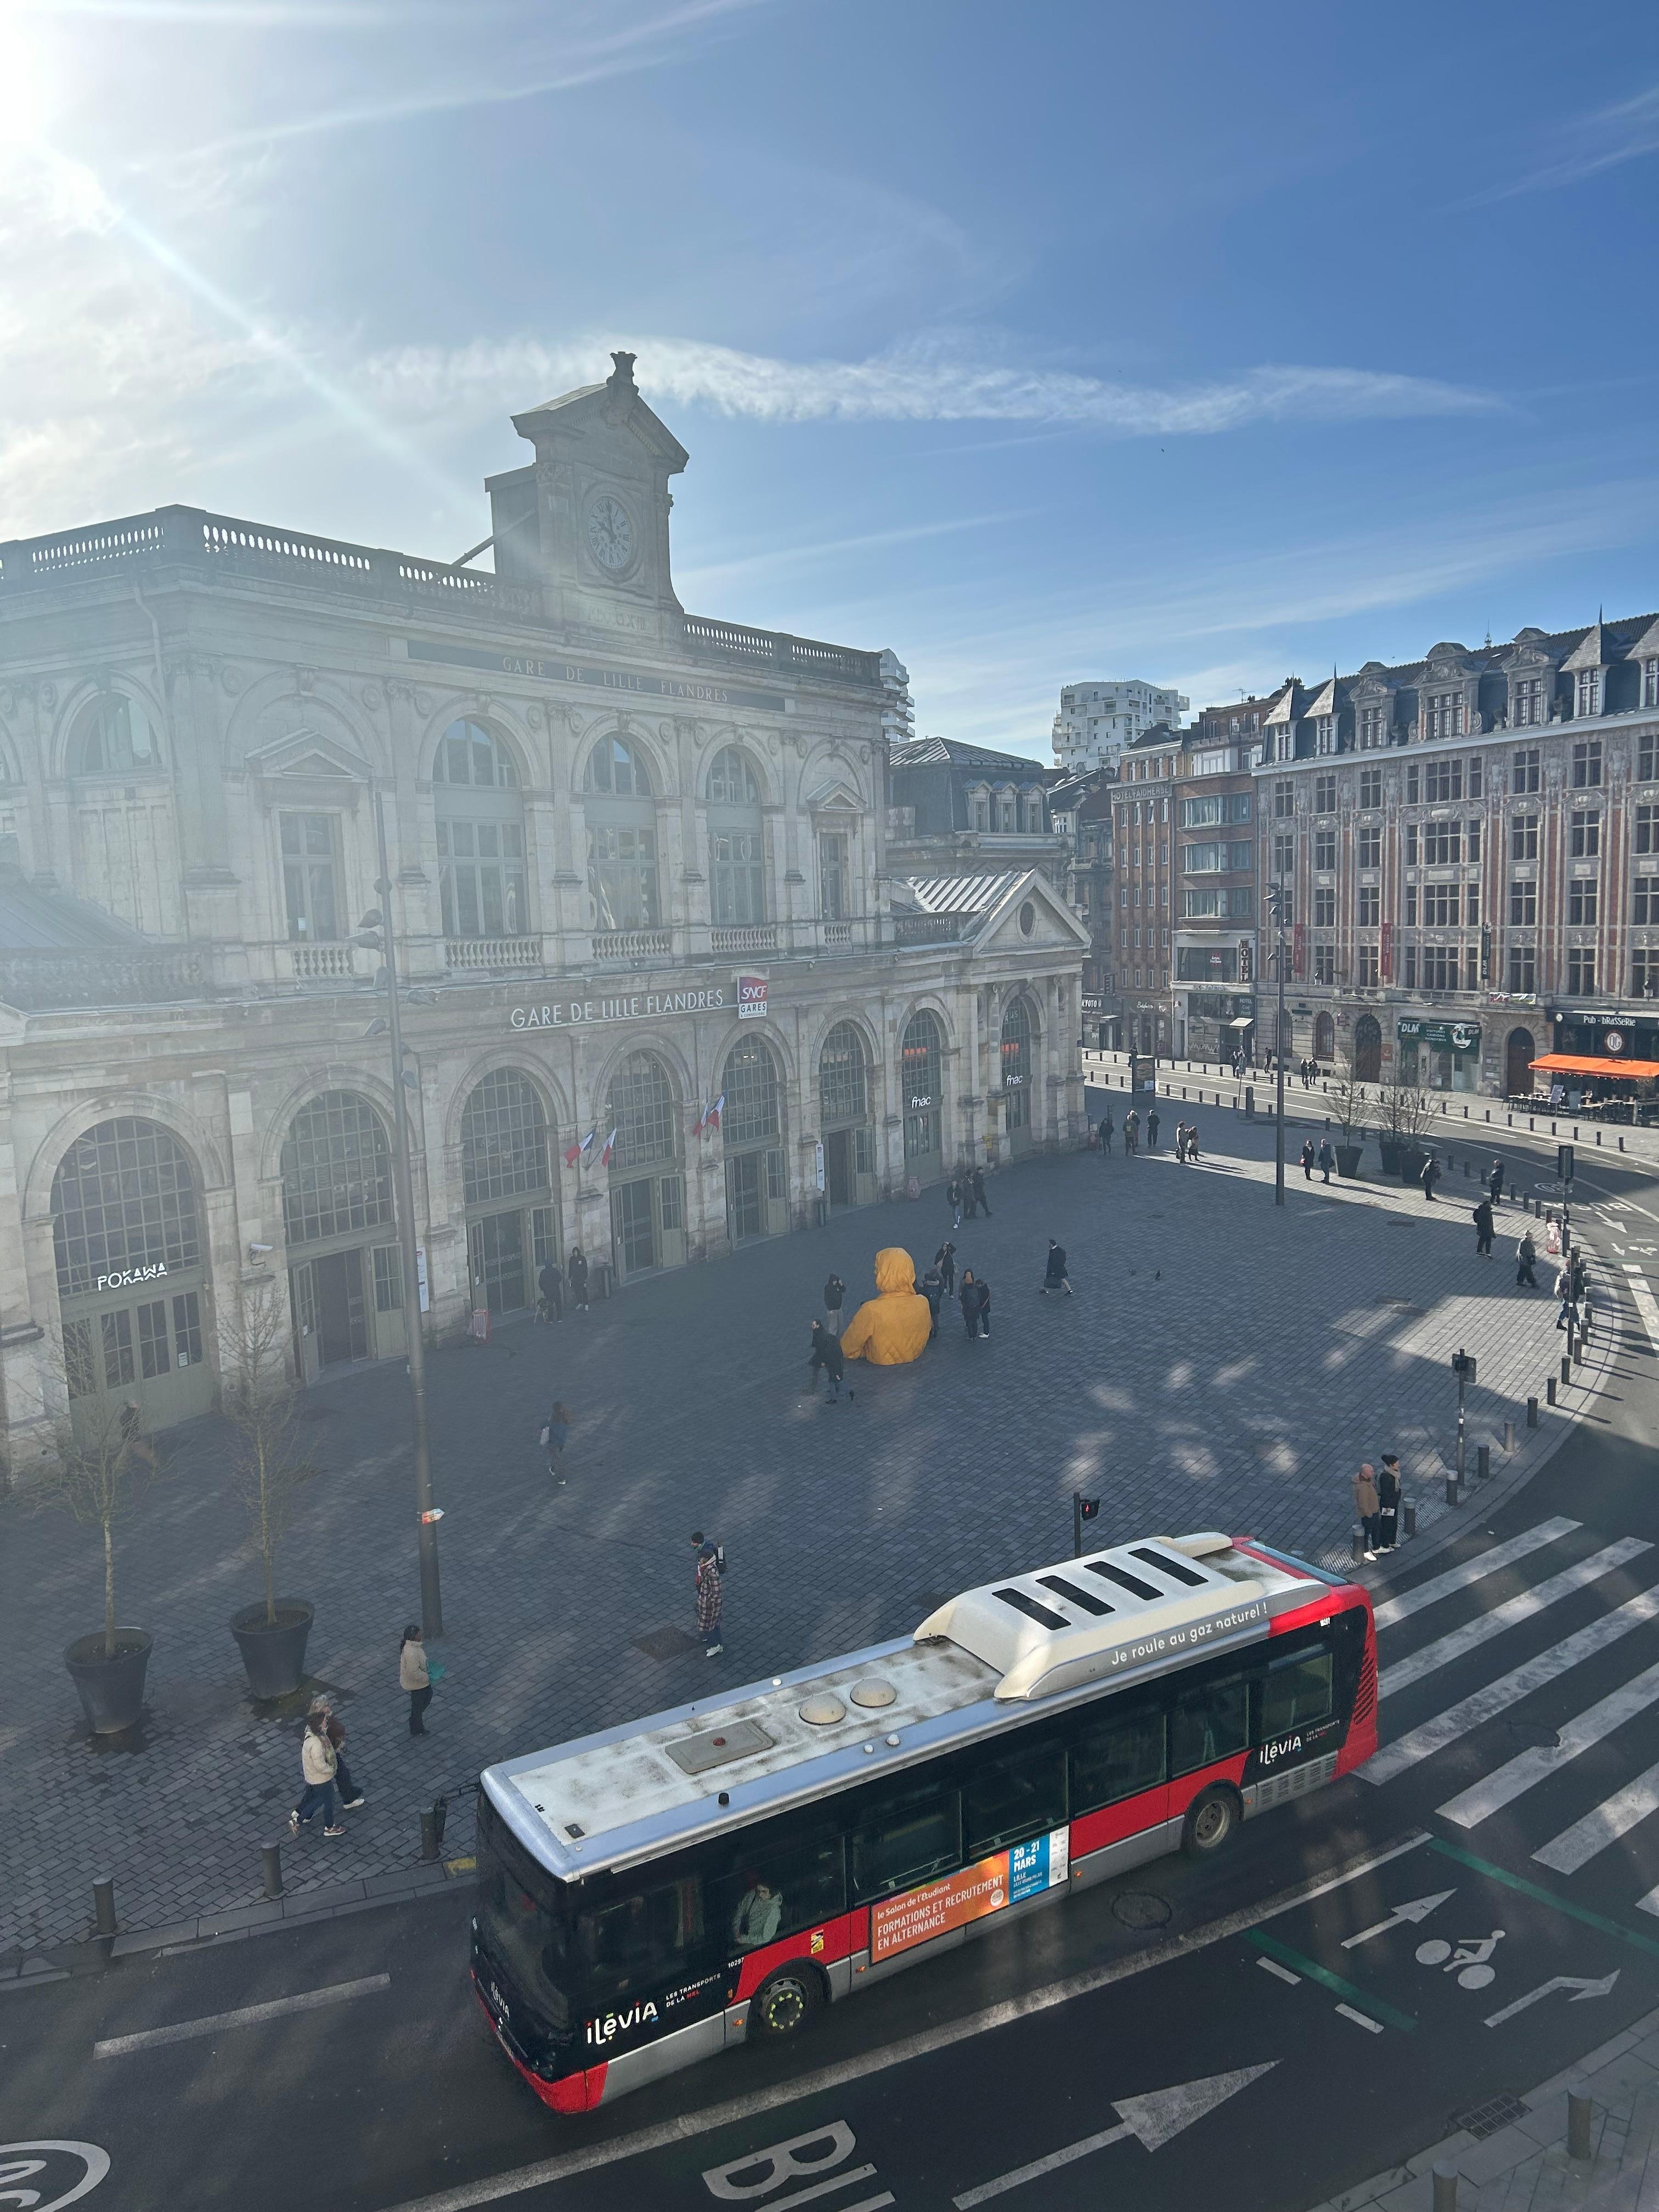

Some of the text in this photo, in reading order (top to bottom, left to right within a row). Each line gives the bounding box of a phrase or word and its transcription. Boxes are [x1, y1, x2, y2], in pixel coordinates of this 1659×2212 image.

[503, 656, 729, 703] GARE DE LILLE FLANDRES
[741, 985, 767, 1000] SNCF
[511, 989, 723, 1028] GARE DE LILLE FLANDRES
[741, 1003, 766, 1013] GARES
[1081, 999, 1097, 1008] KYOTO
[1583, 1015, 1596, 1024] Pub
[1401, 1023, 1420, 1033] DLM
[1609, 1035, 1621, 1049] QG
[1006, 1075, 1023, 1086] fnac
[912, 1096, 931, 1109] fnac
[97, 1262, 167, 1291] POKAWA
[1111, 1651, 1128, 1665] Je
[1132, 1638, 1165, 1659] roule
[1169, 1632, 1186, 1646] au
[1190, 1623, 1213, 1643] gaz
[1216, 1603, 1260, 1629] naturel
[1014, 1847, 1024, 1860] 20
[1031, 1840, 1040, 1853] 21
[1014, 1854, 1036, 1872] MARS
[1014, 1872, 1026, 1882] LILLE
[878, 1905, 931, 1937] FORMATIONS
[933, 1899, 943, 1914] ET
[945, 1874, 1003, 1909] RECRUTEMENT
[886, 1903, 906, 1916] Salon
[907, 1898, 916, 1907] de
[878, 1912, 945, 1951] EN ALTERNANCE
[666, 1973, 721, 2001] LES TRANSPORTS
[666, 2000, 675, 2008] DE
